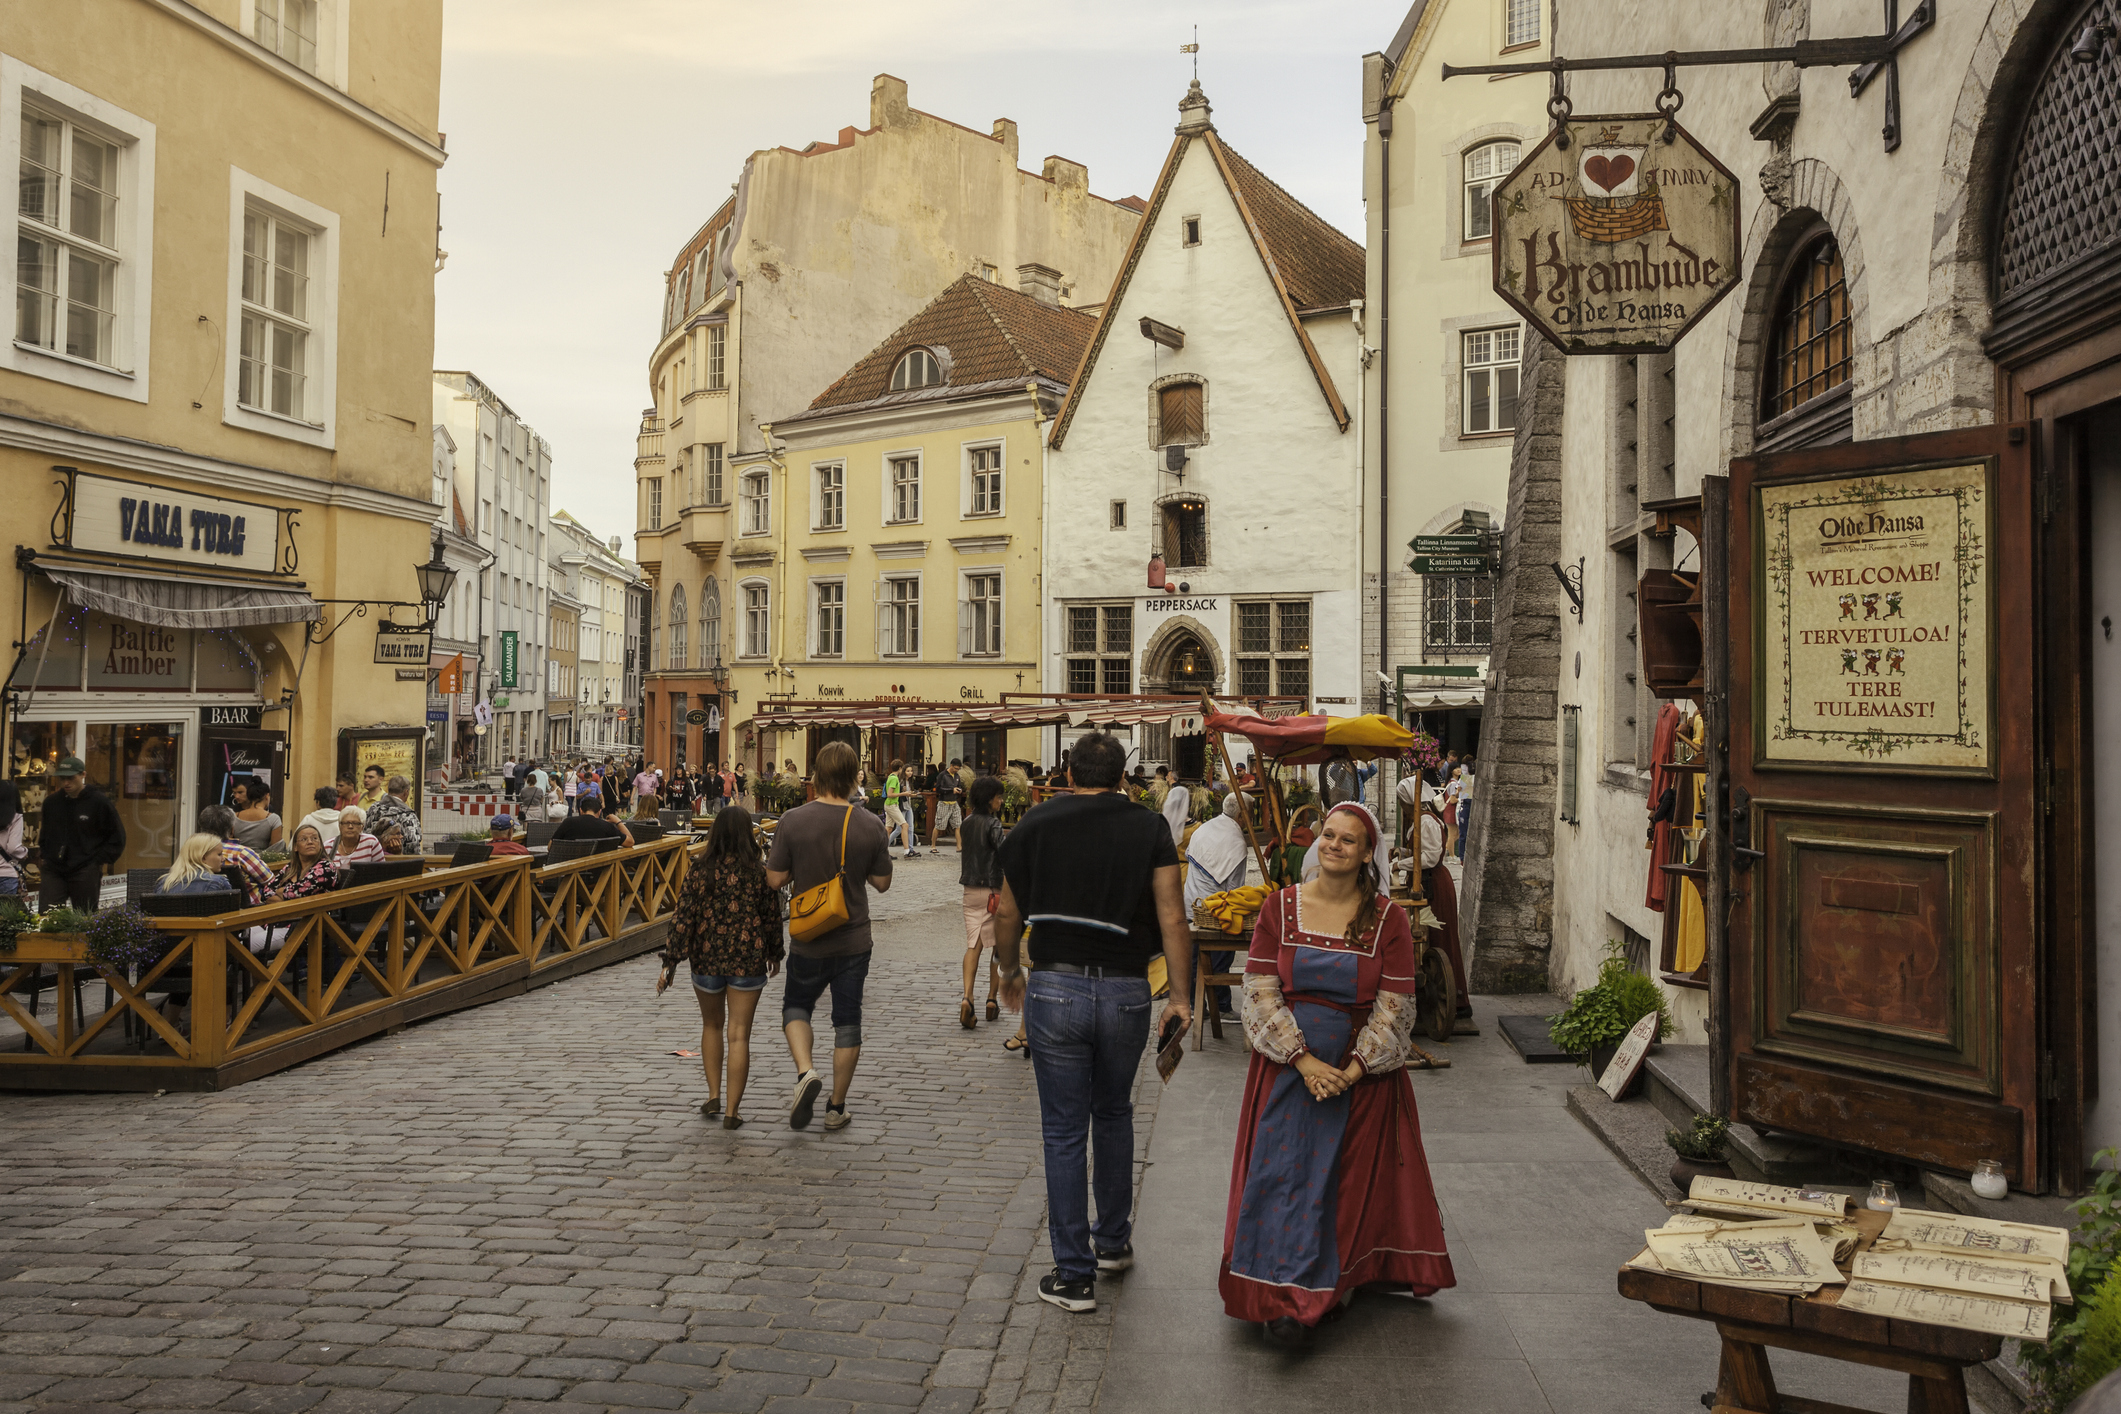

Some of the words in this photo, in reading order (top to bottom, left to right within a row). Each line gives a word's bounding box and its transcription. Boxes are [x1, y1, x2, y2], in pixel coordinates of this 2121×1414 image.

[1551, 297, 1608, 325] Olde
[120, 497, 183, 549] VANA
[190, 508, 246, 556] TURG
[1818, 516, 1864, 539] Olde
[1429, 558, 1462, 566] Katariina
[1463, 558, 1481, 566] Käik
[1806, 561, 1940, 588] WELCOME!
[1146, 599, 1217, 612] PEPPERSACK
[111, 623, 175, 653] Baltic
[1800, 624, 1950, 645] TERVETULOA!
[380, 644, 401, 658] VANA
[404, 644, 424, 658] TURG
[505, 636, 514, 683] SALAMANDER
[102, 648, 177, 676] Amber
[1846, 681, 1902, 697] TERE
[210, 707, 250, 724] BAAR
[1813, 701, 1935, 718] TULEMAST!
[226, 749, 260, 766] Baar
